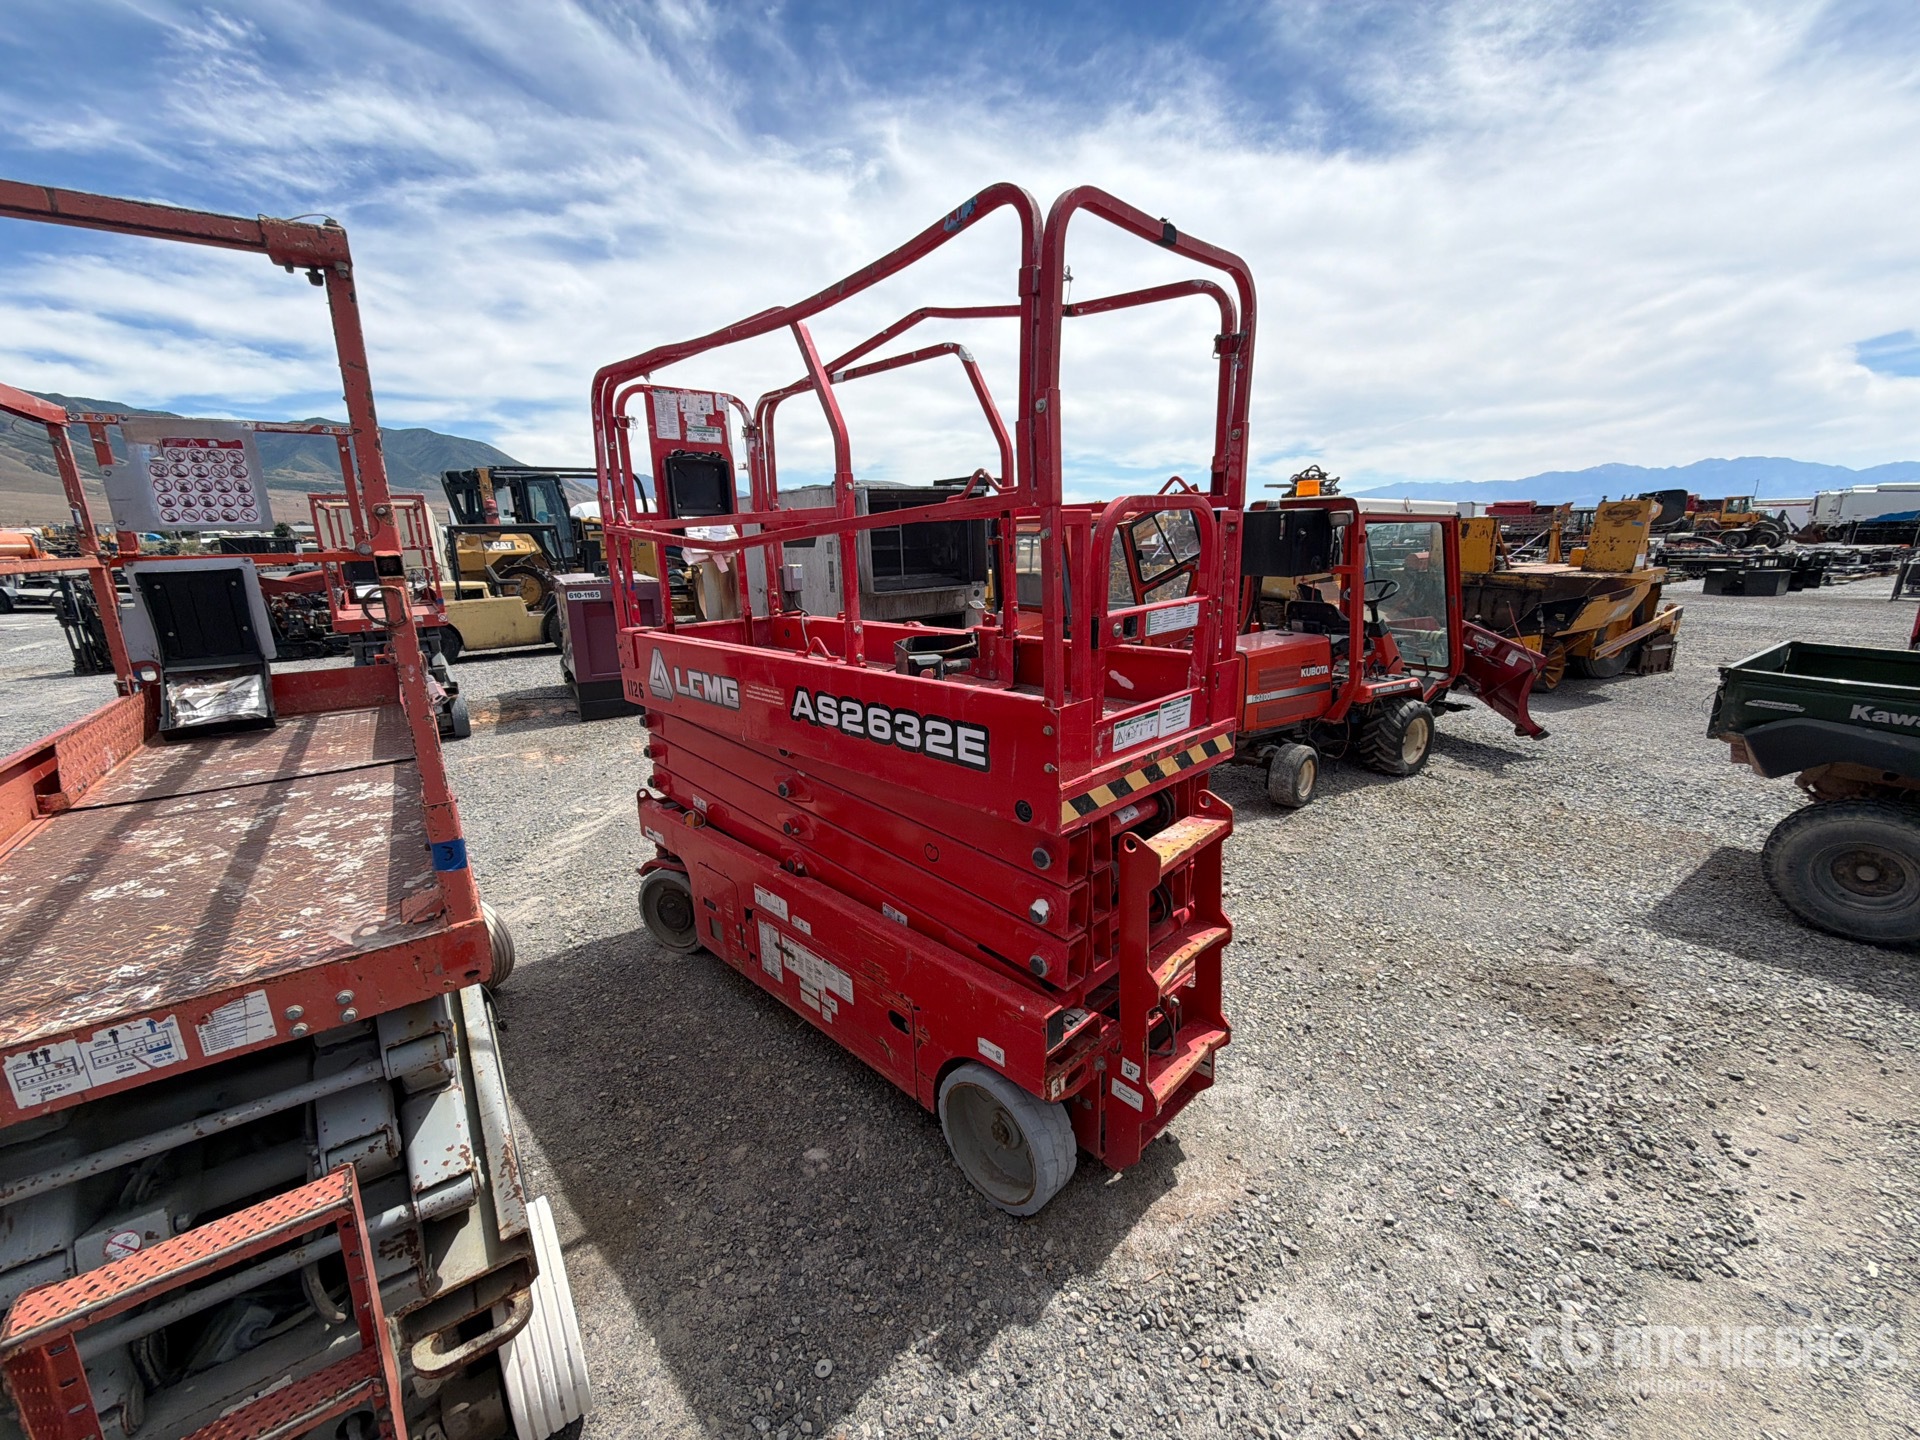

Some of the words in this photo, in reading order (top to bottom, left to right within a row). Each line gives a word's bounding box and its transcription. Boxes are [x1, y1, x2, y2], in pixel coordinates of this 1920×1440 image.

[492, 541, 513, 550] CAT
[568, 590, 600, 599] 610-1165
[1300, 665, 1329, 678] KUBOTA
[627, 679, 644, 699] 1126
[792, 690, 986, 766] AS2632E
